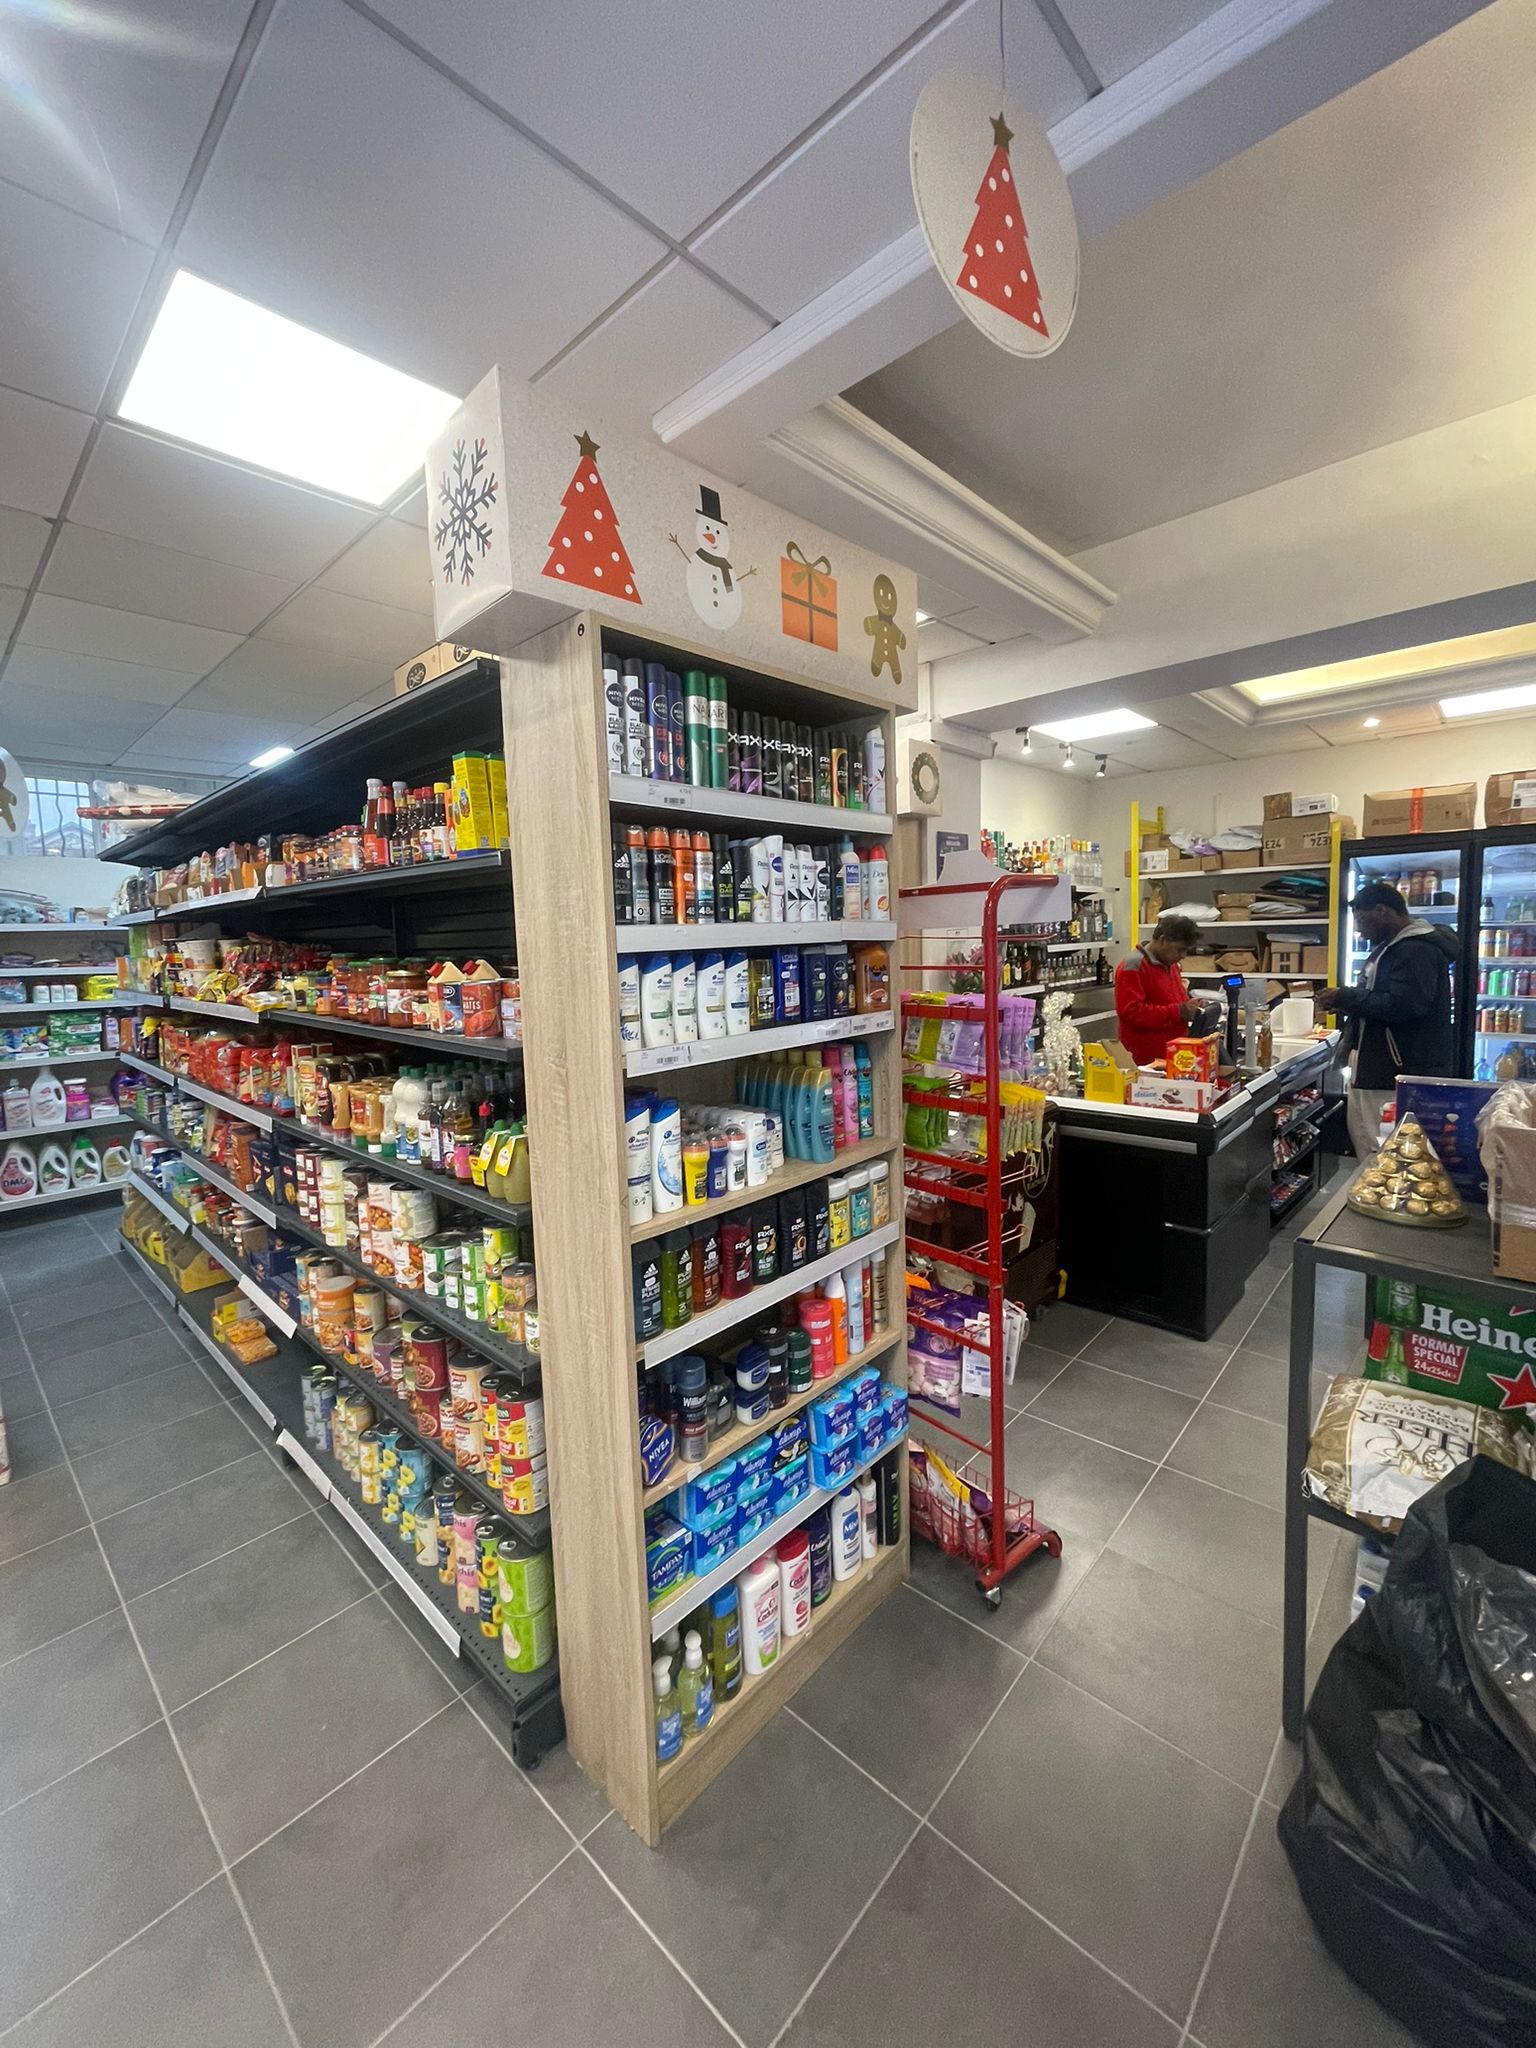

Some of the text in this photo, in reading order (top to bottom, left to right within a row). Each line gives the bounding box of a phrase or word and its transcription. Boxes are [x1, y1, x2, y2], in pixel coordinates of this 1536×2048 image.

[3, 1177, 27, 1187] OMO
[1421, 1302, 1536, 1359] Heine
[1412, 1334, 1463, 1357] FORMAT
[1414, 1347, 1458, 1368] SPECIAL
[649, 1439, 670, 1462] NIVEA
[744, 1456, 767, 1473] always
[707, 1482, 731, 1500] always
[708, 1525, 732, 1545] always
[651, 1552, 683, 1581] TAMPAX
